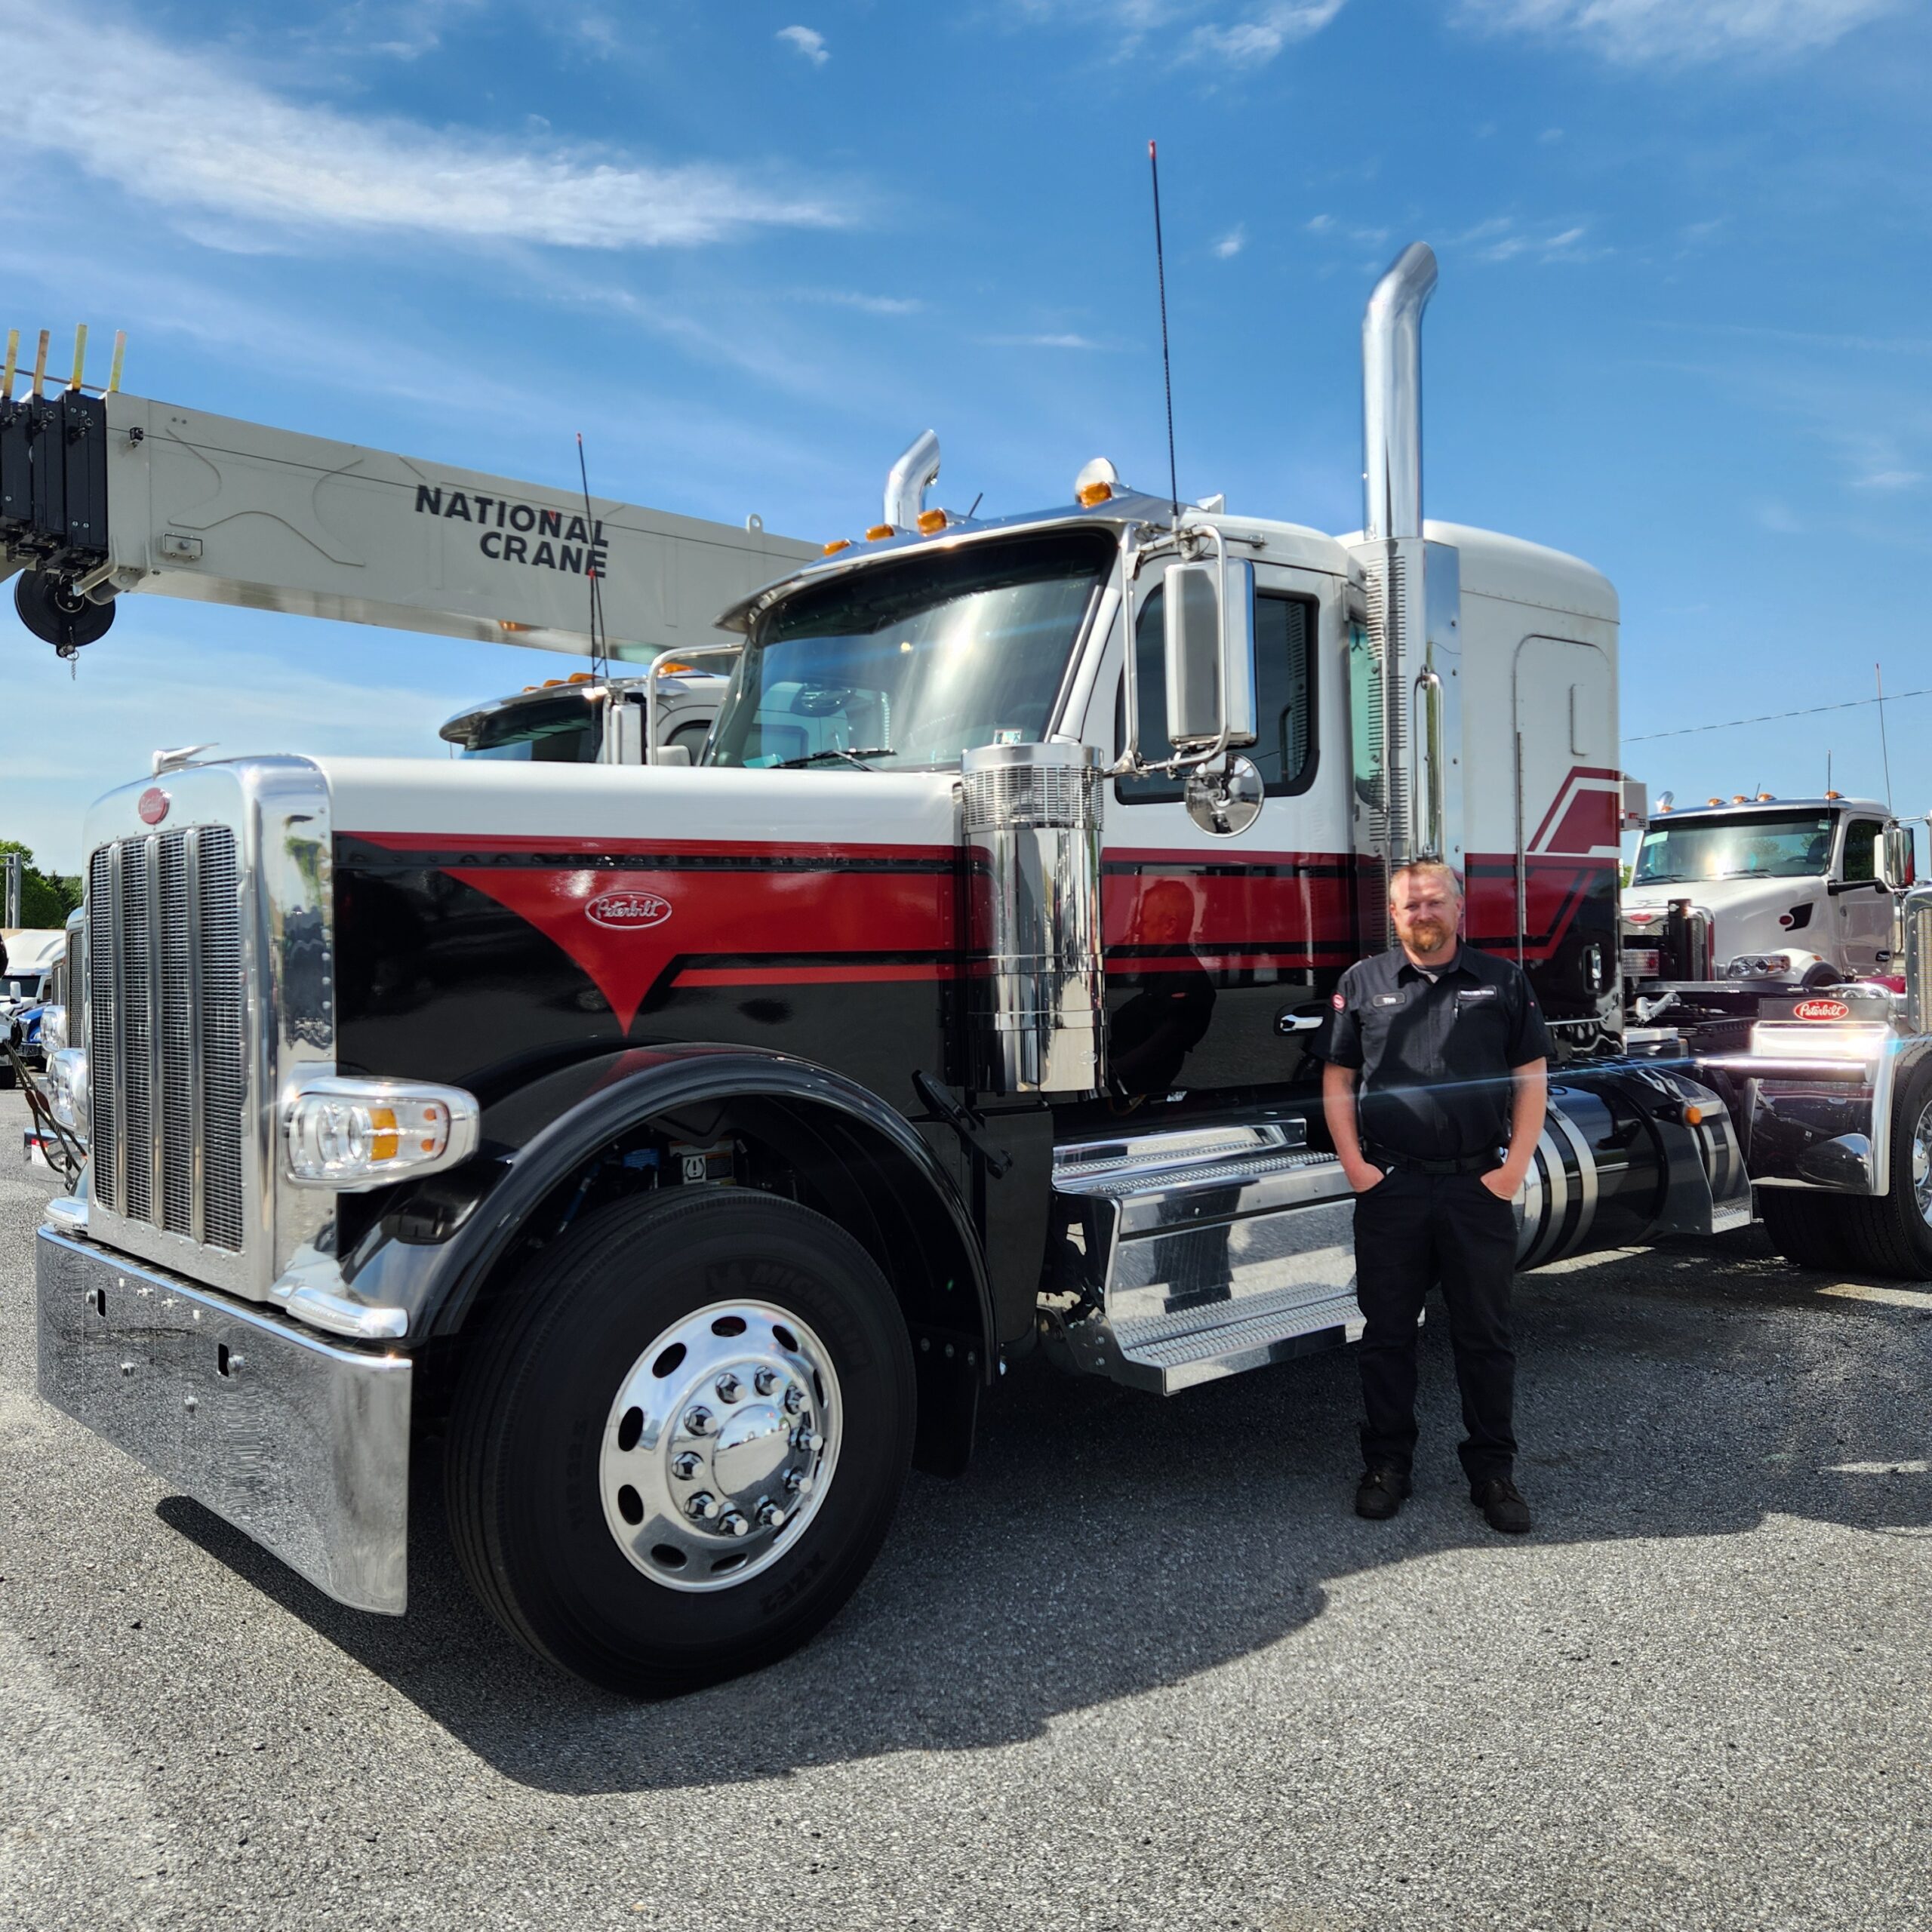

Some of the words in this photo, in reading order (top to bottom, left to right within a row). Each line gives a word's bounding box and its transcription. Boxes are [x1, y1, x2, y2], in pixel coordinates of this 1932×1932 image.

[415, 484, 608, 548] NATIONAL
[479, 531, 608, 579] CRANE
[595, 898, 664, 919] Peterbilt
[1799, 1004, 1845, 1017] Peterbilt
